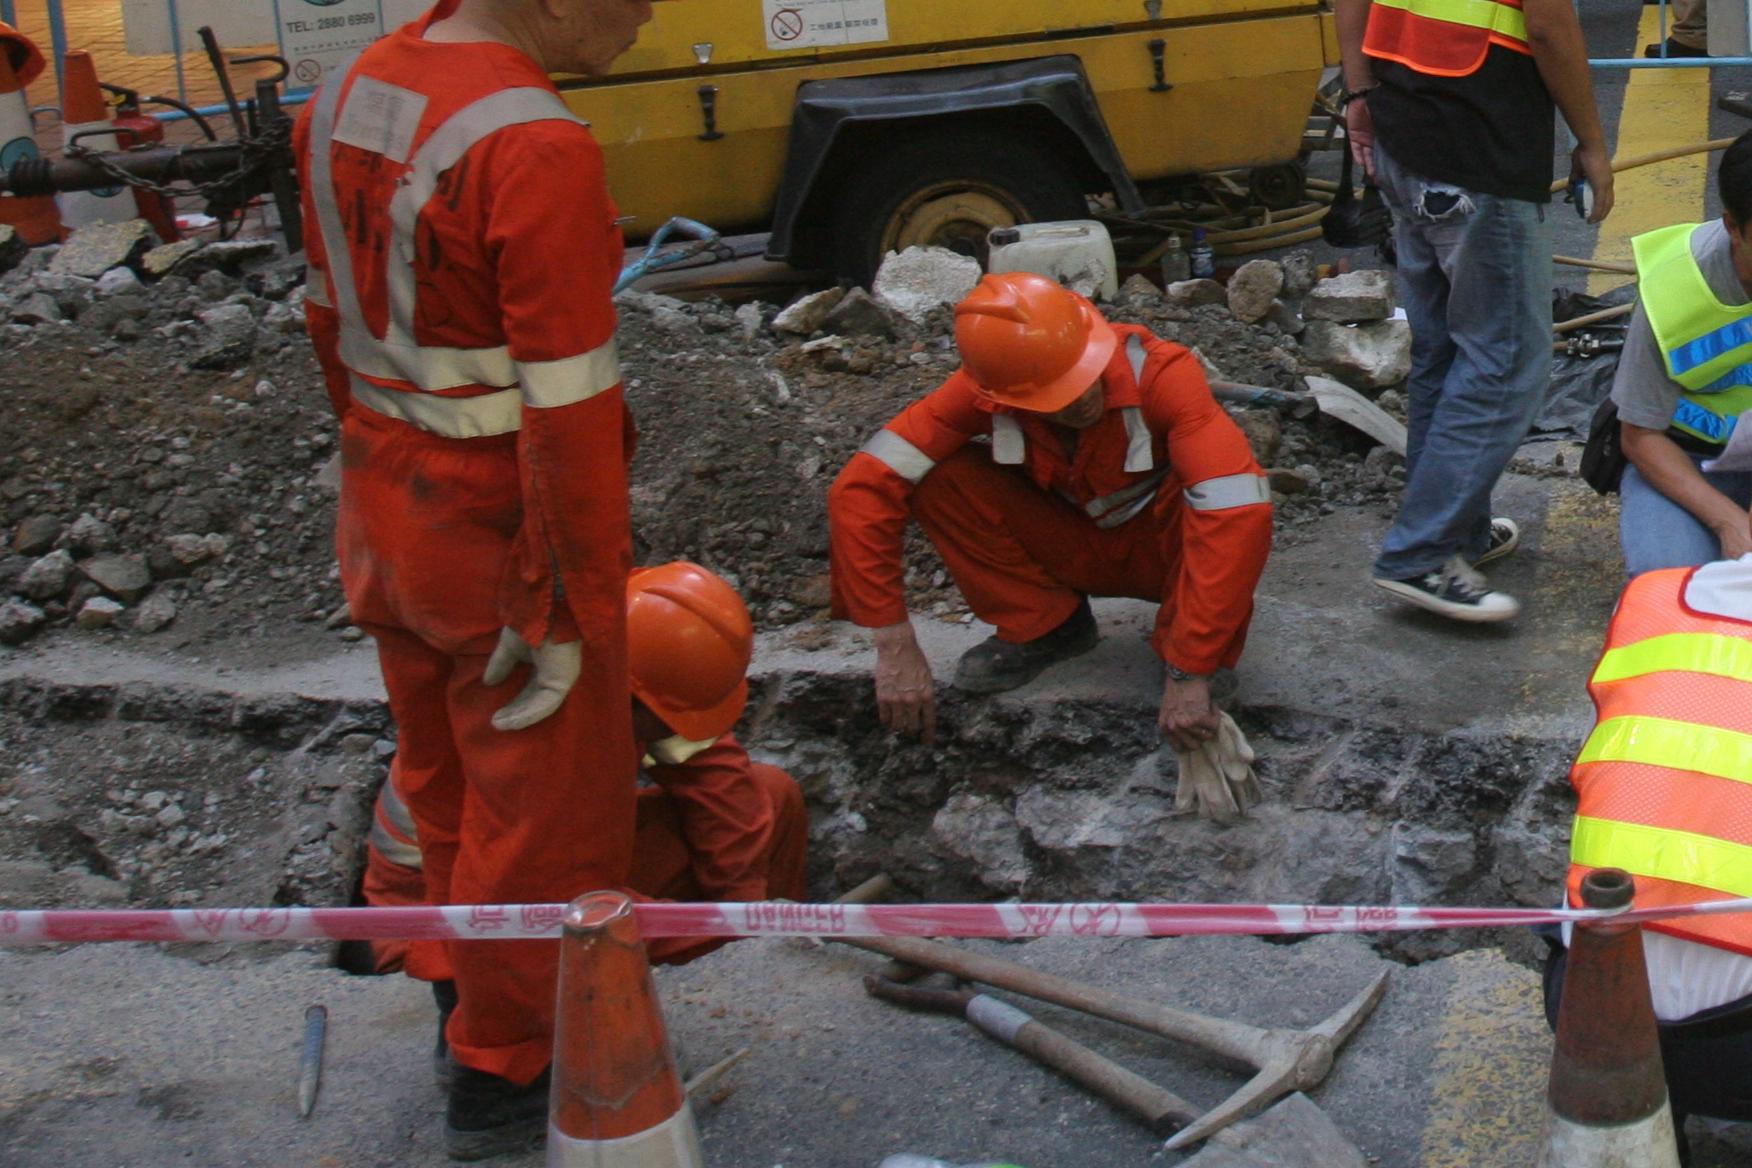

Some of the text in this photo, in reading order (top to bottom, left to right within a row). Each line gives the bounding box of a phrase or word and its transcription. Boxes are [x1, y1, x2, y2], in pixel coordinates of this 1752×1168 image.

[286, 12, 376, 33] TEL: 2880 6999
